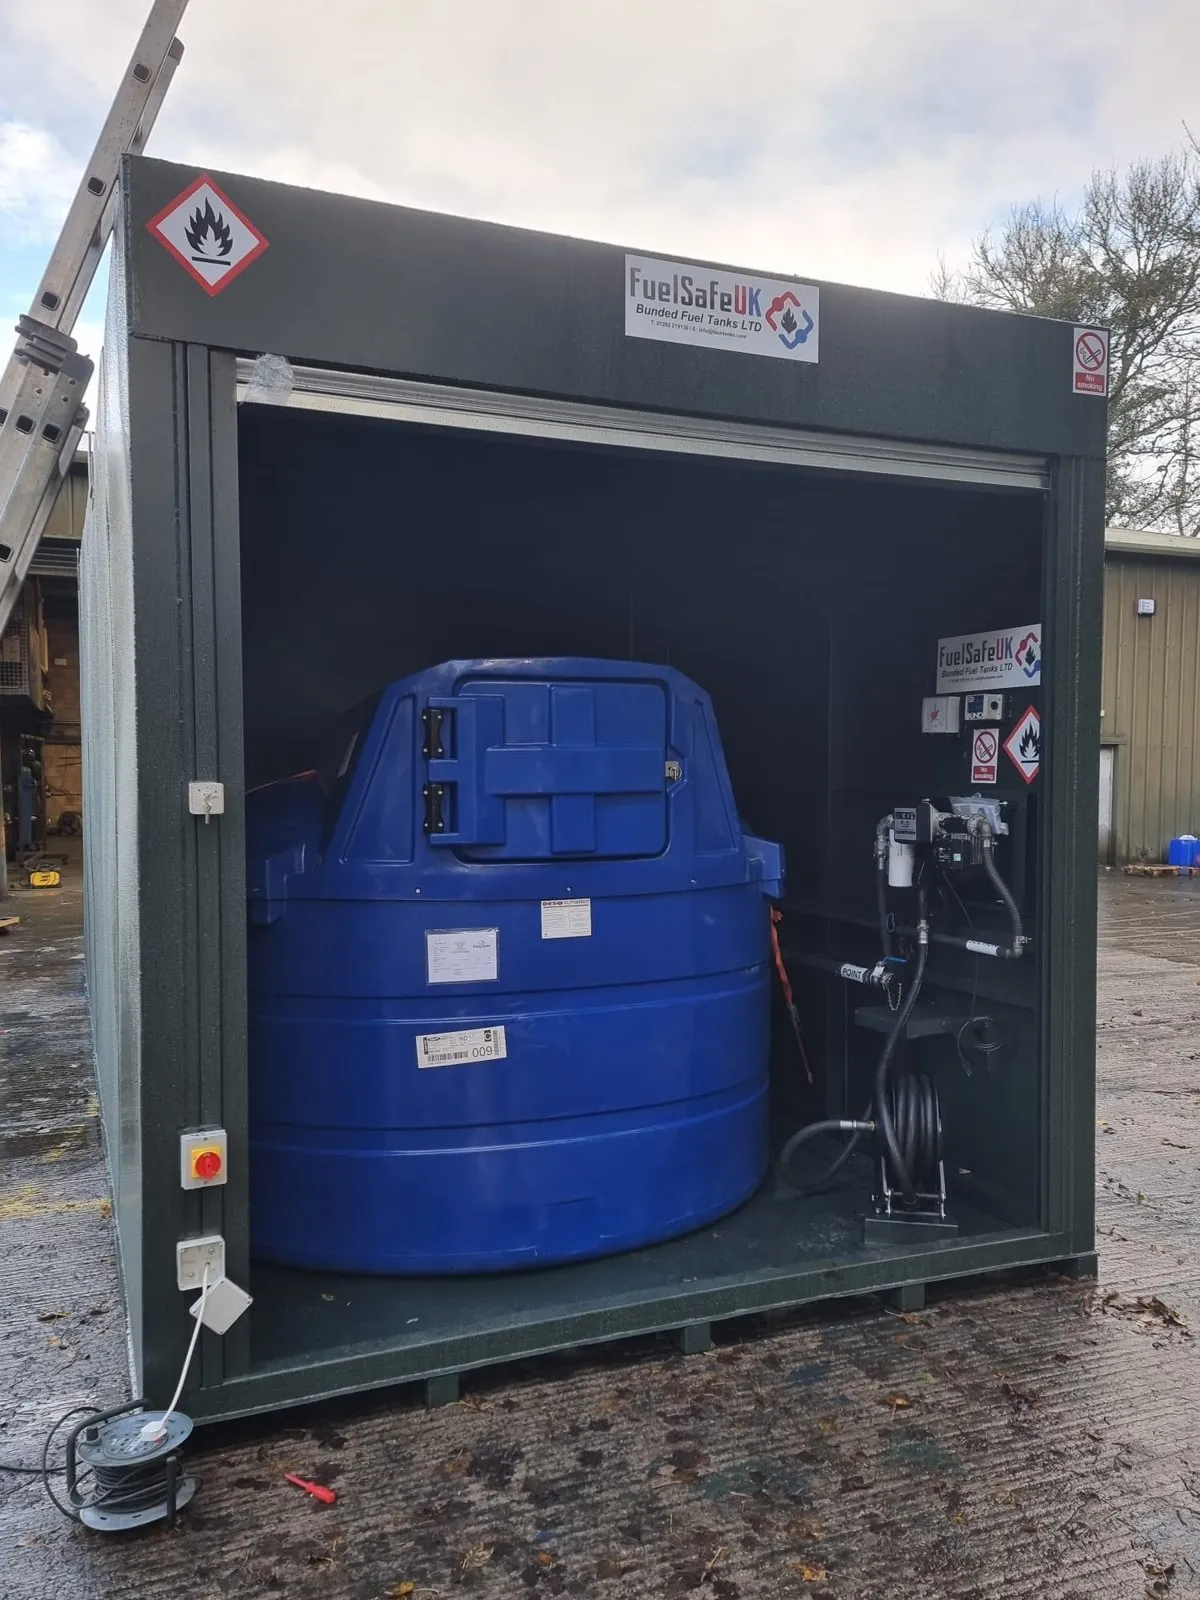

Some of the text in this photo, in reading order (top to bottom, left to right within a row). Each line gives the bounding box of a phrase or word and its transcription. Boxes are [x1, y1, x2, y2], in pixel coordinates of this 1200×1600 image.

[636, 304, 762, 332] Bunded Fuel Tanks LTD
[1077, 382, 1103, 391] smoking
[942, 663, 1013, 678] Bunded Fuel Tanks LTD
[842, 967, 862, 980] POINT
[472, 1046, 493, 1058] 009
